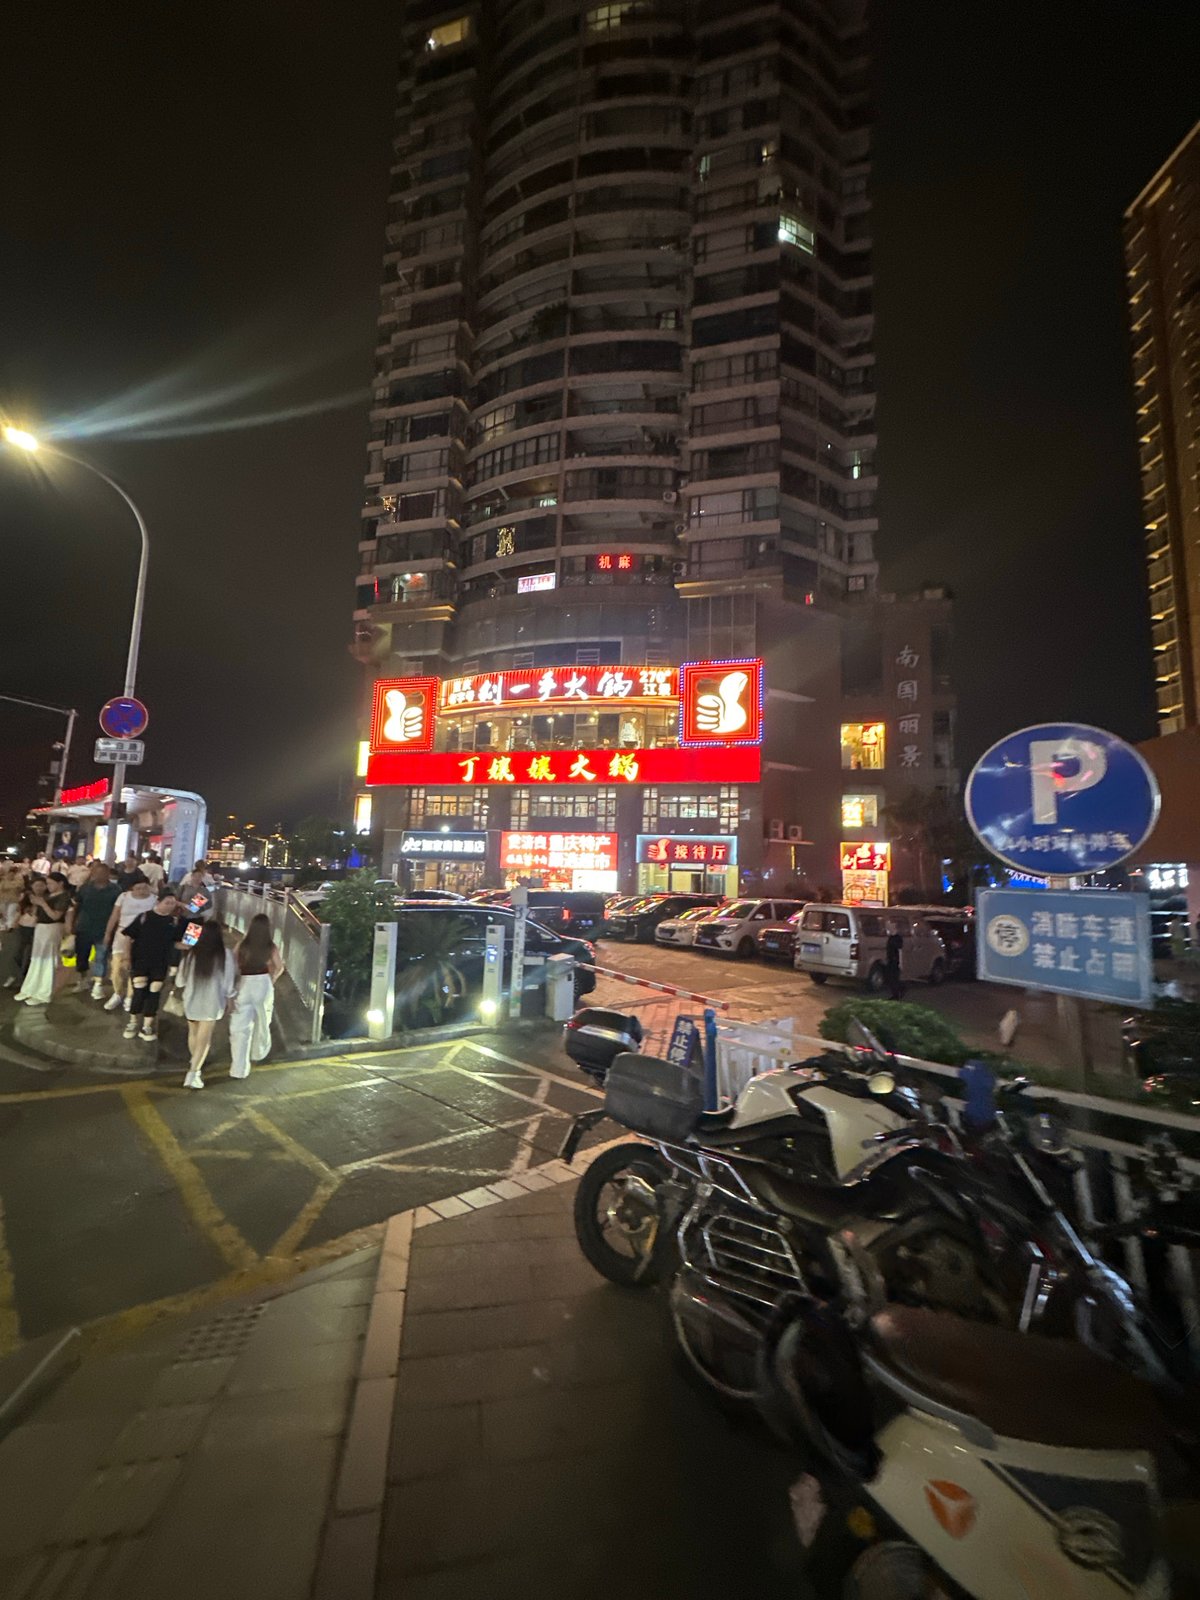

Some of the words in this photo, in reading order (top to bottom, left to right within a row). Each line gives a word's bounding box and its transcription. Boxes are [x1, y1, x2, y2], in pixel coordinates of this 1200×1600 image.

[598, 555, 631, 569] 机麻
[896, 645, 921, 768] 南国丽景
[1029, 740, 1108, 825] P
[675, 844, 726, 860] 接待厅
[670, 1020, 692, 1066] 禁止停
